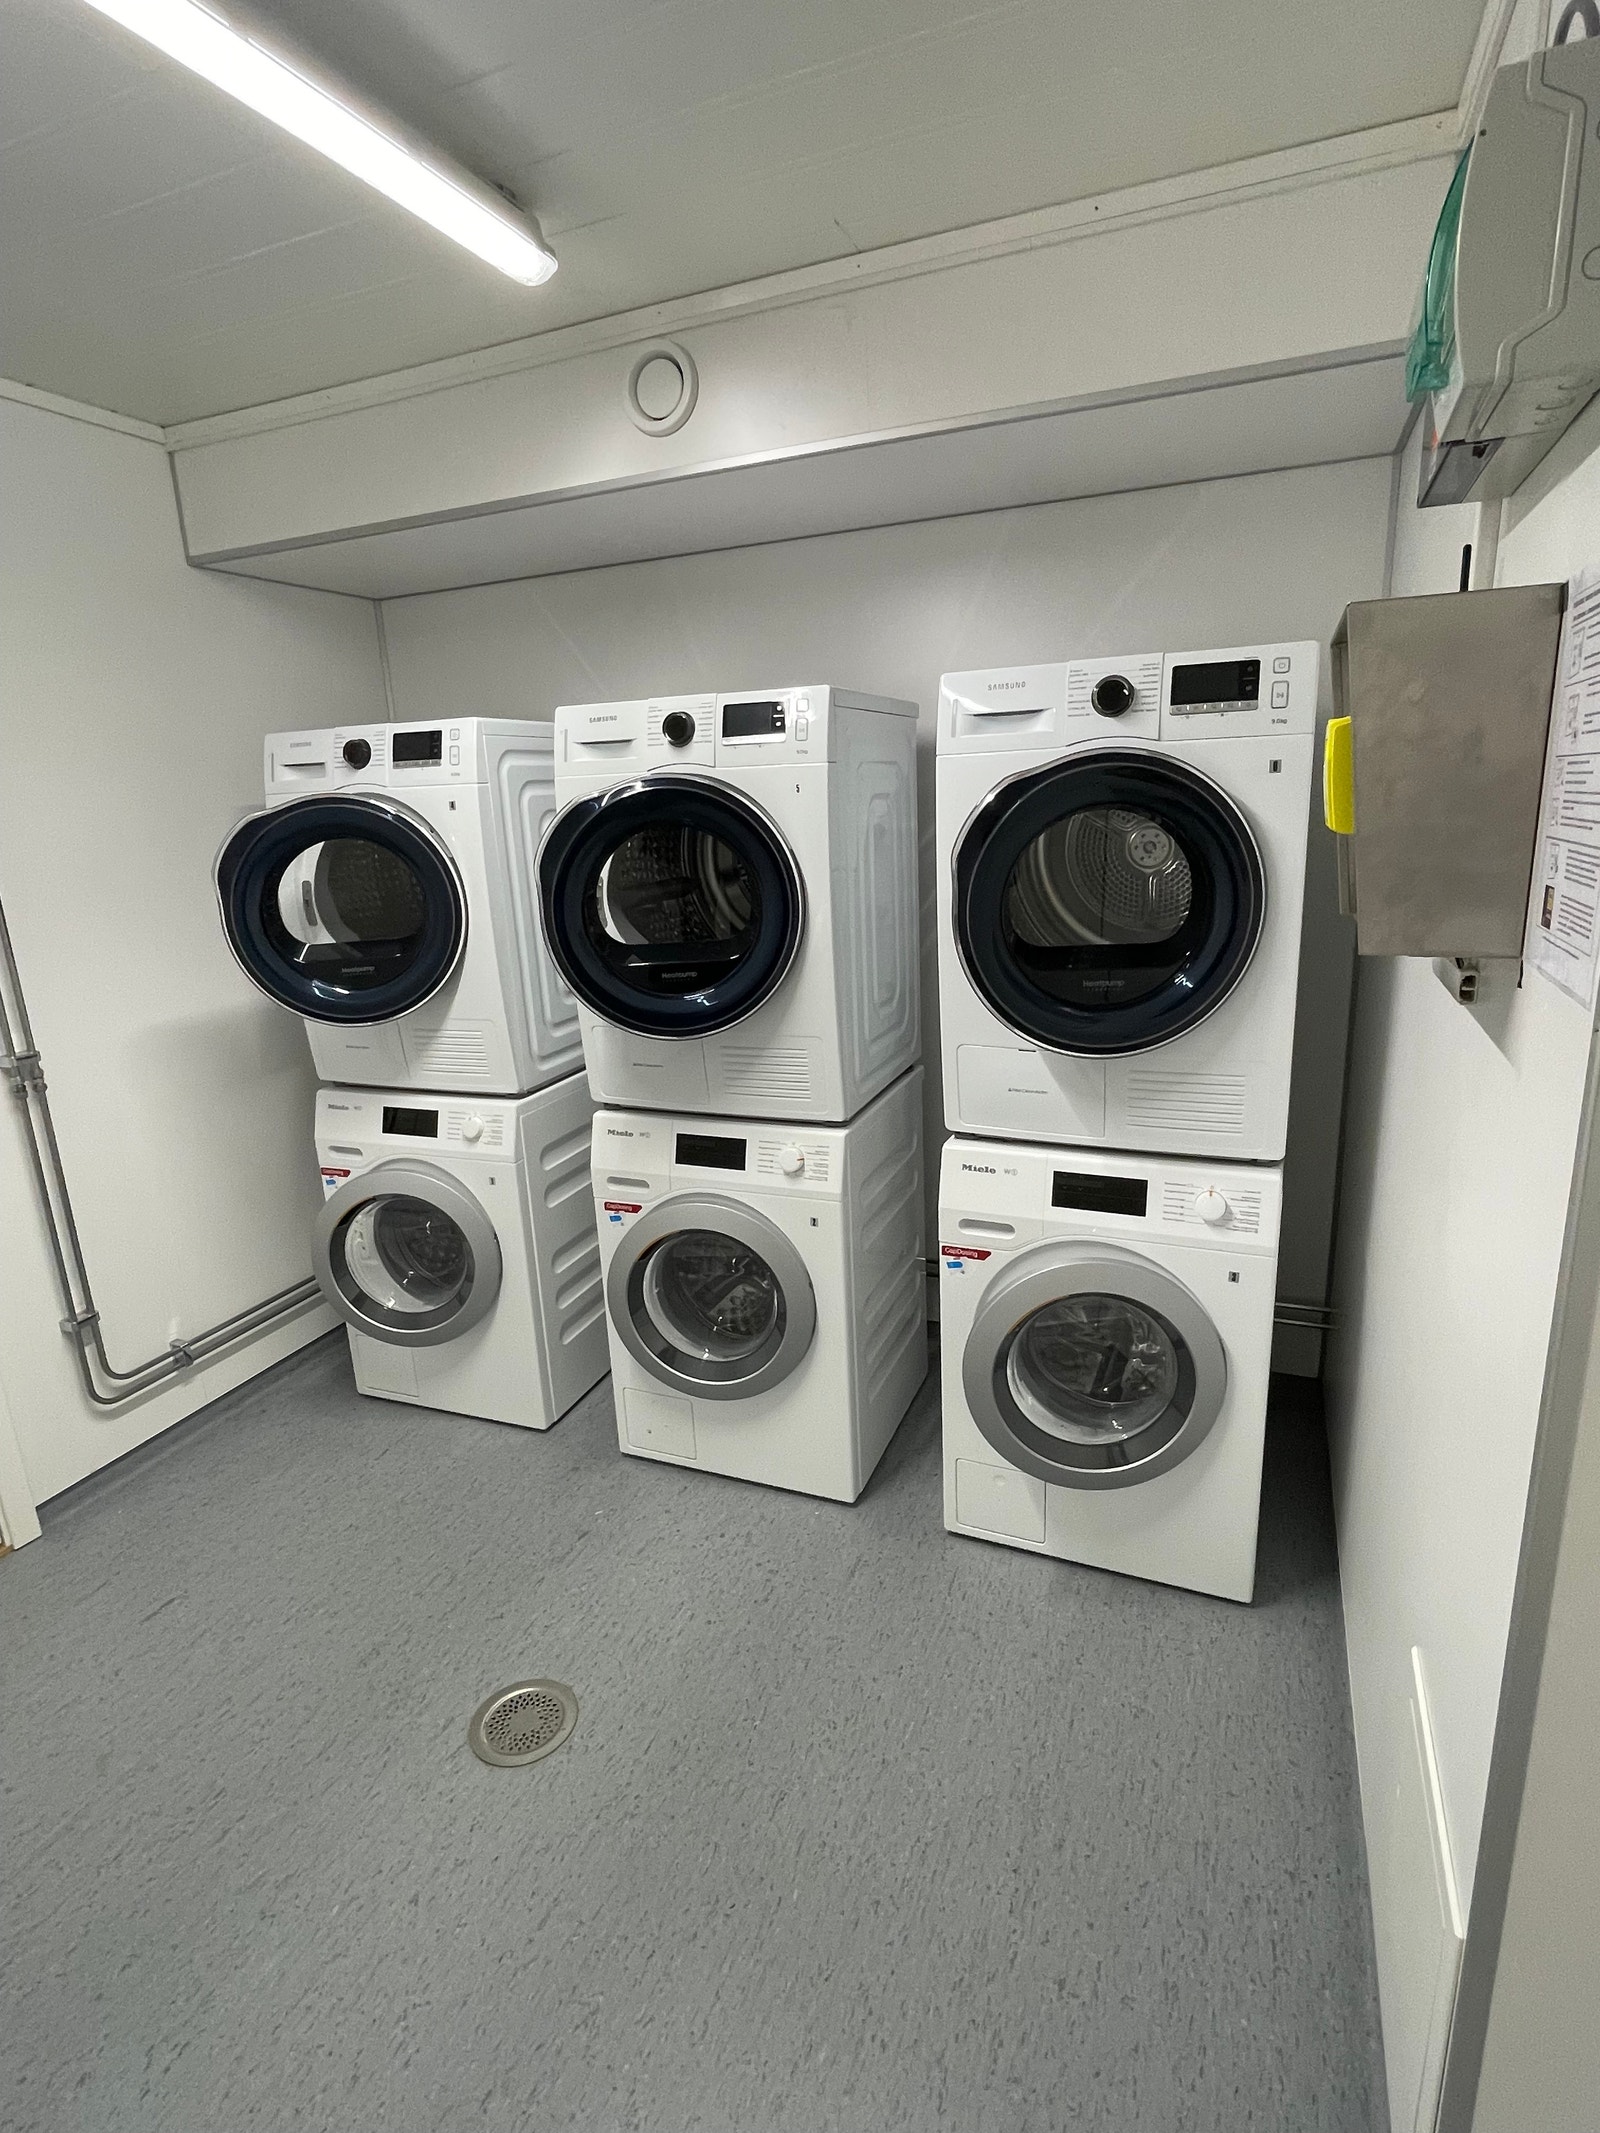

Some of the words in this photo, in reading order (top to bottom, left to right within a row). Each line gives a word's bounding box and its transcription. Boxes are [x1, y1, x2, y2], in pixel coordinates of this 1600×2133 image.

[987, 681, 1027, 691] SAMSUNG
[606, 1128, 634, 1138] Miele
[961, 1163, 997, 1175] Miele
[944, 1246, 978, 1258] CapDosing
